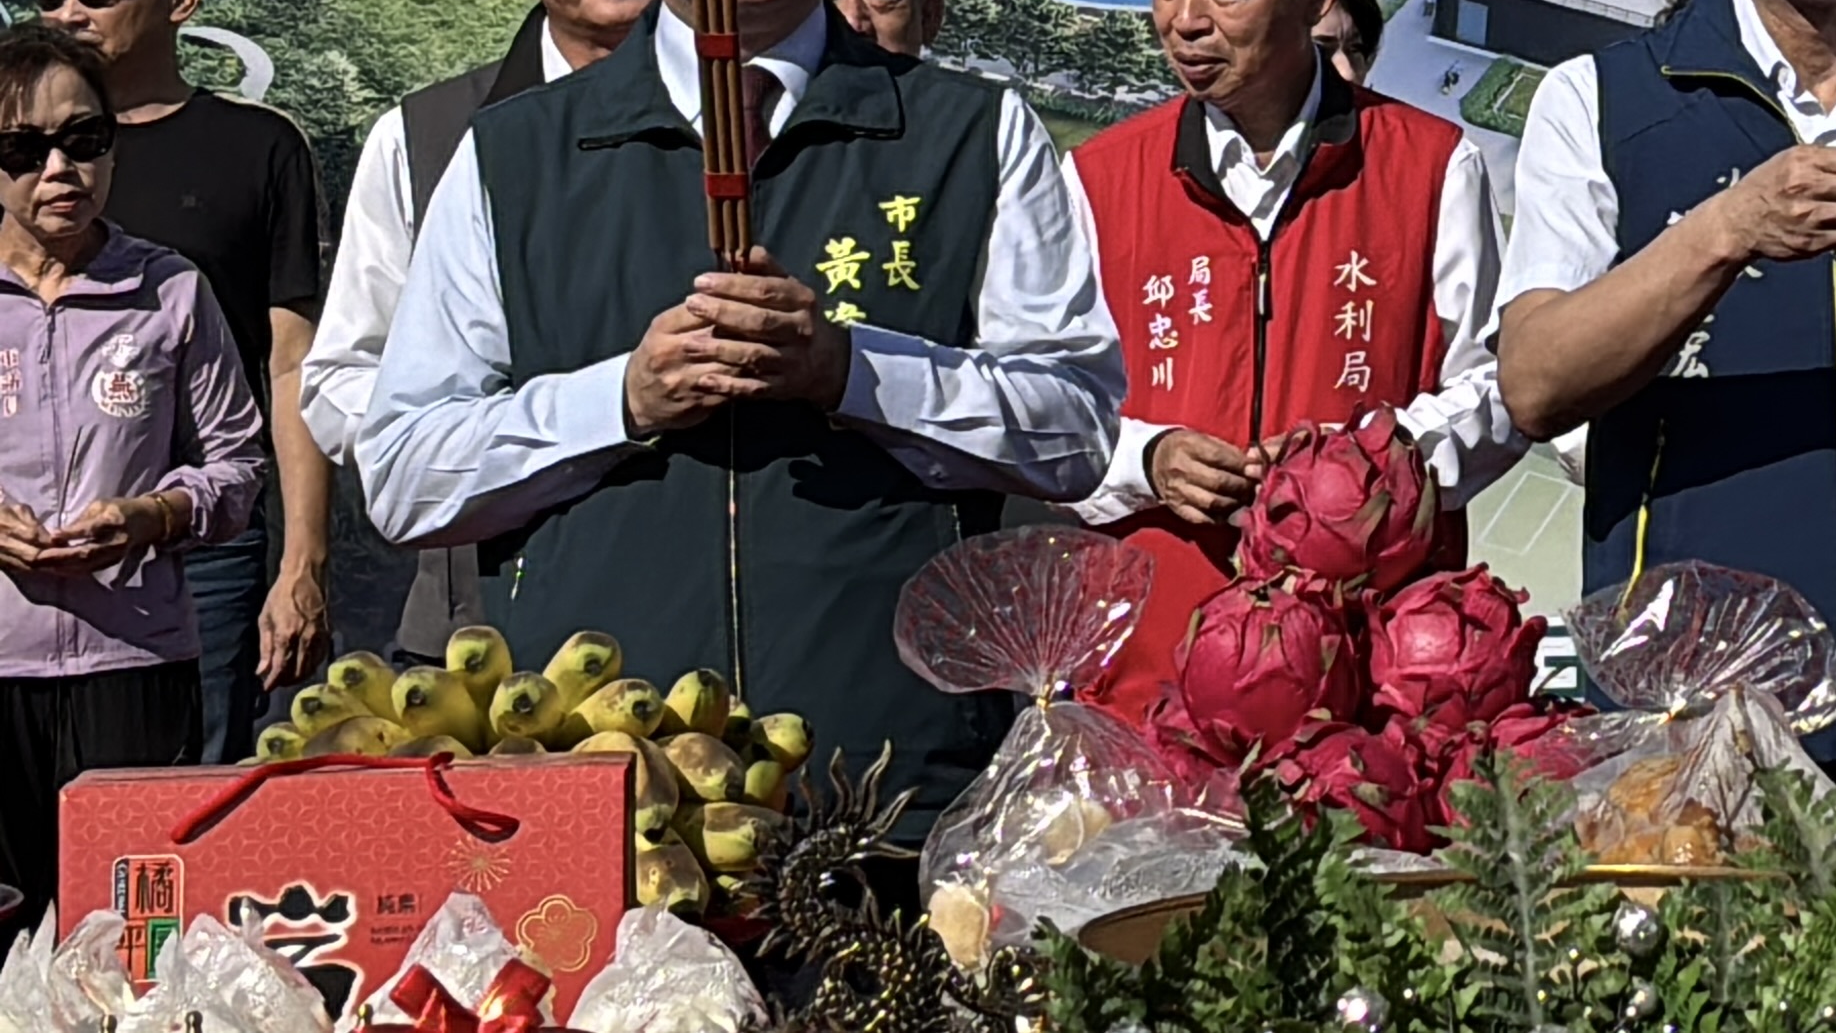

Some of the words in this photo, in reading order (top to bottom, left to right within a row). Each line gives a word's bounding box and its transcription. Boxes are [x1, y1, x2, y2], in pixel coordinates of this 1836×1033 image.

[878, 194, 922, 291] 市長
[1187, 255, 1214, 325] 局長
[1141, 273, 1179, 393] 邱忠川
[1333, 249, 1378, 394] 水利局
